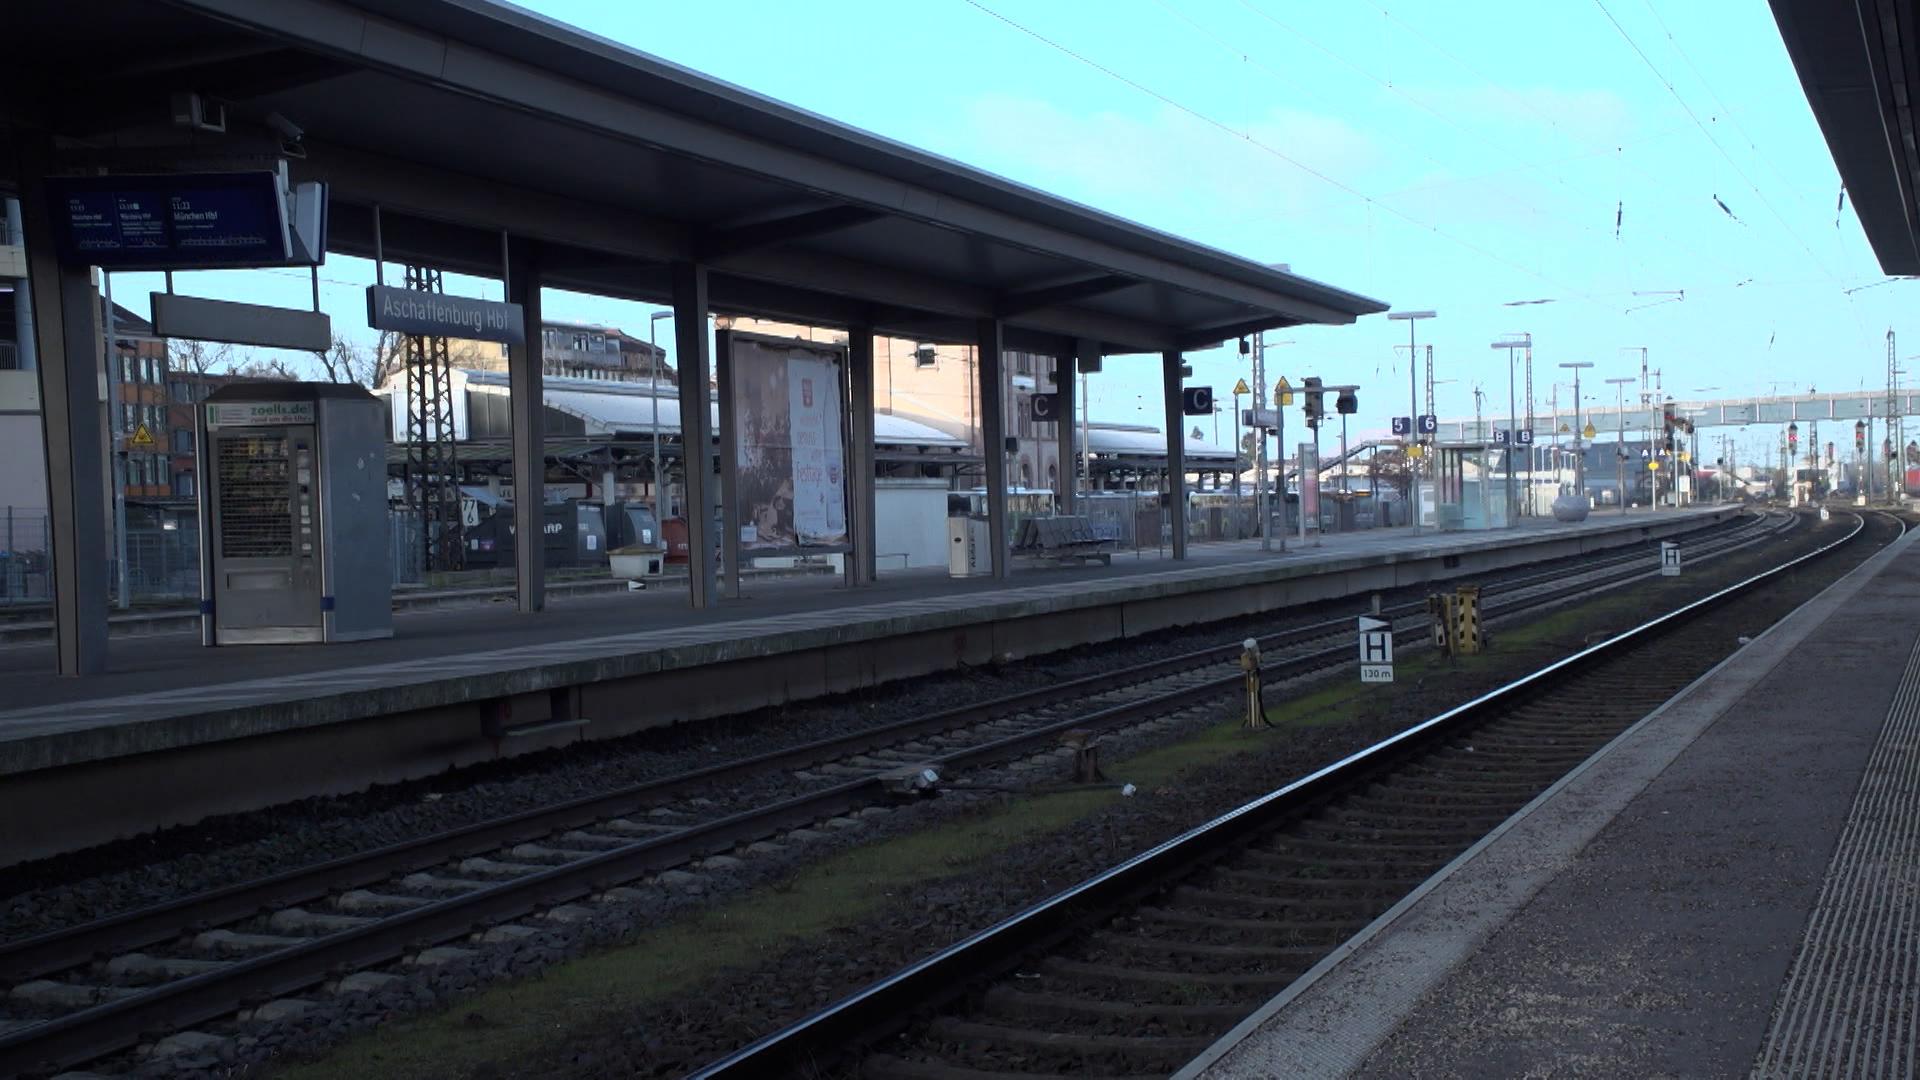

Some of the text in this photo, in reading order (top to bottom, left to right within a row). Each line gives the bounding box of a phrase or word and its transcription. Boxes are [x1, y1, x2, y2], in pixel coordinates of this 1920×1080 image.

[383, 295, 509, 332] Aschaffenburg Hbf
[1034, 395, 1049, 416] C
[1193, 388, 1209, 410] C
[1393, 418, 1404, 432] 5
[1425, 416, 1435, 430] 6
[1495, 431, 1505, 442] B
[1521, 431, 1531, 442] B
[1665, 551, 1677, 565] H
[1366, 633, 1386, 660] H
[1364, 669, 1391, 679] 130 m
